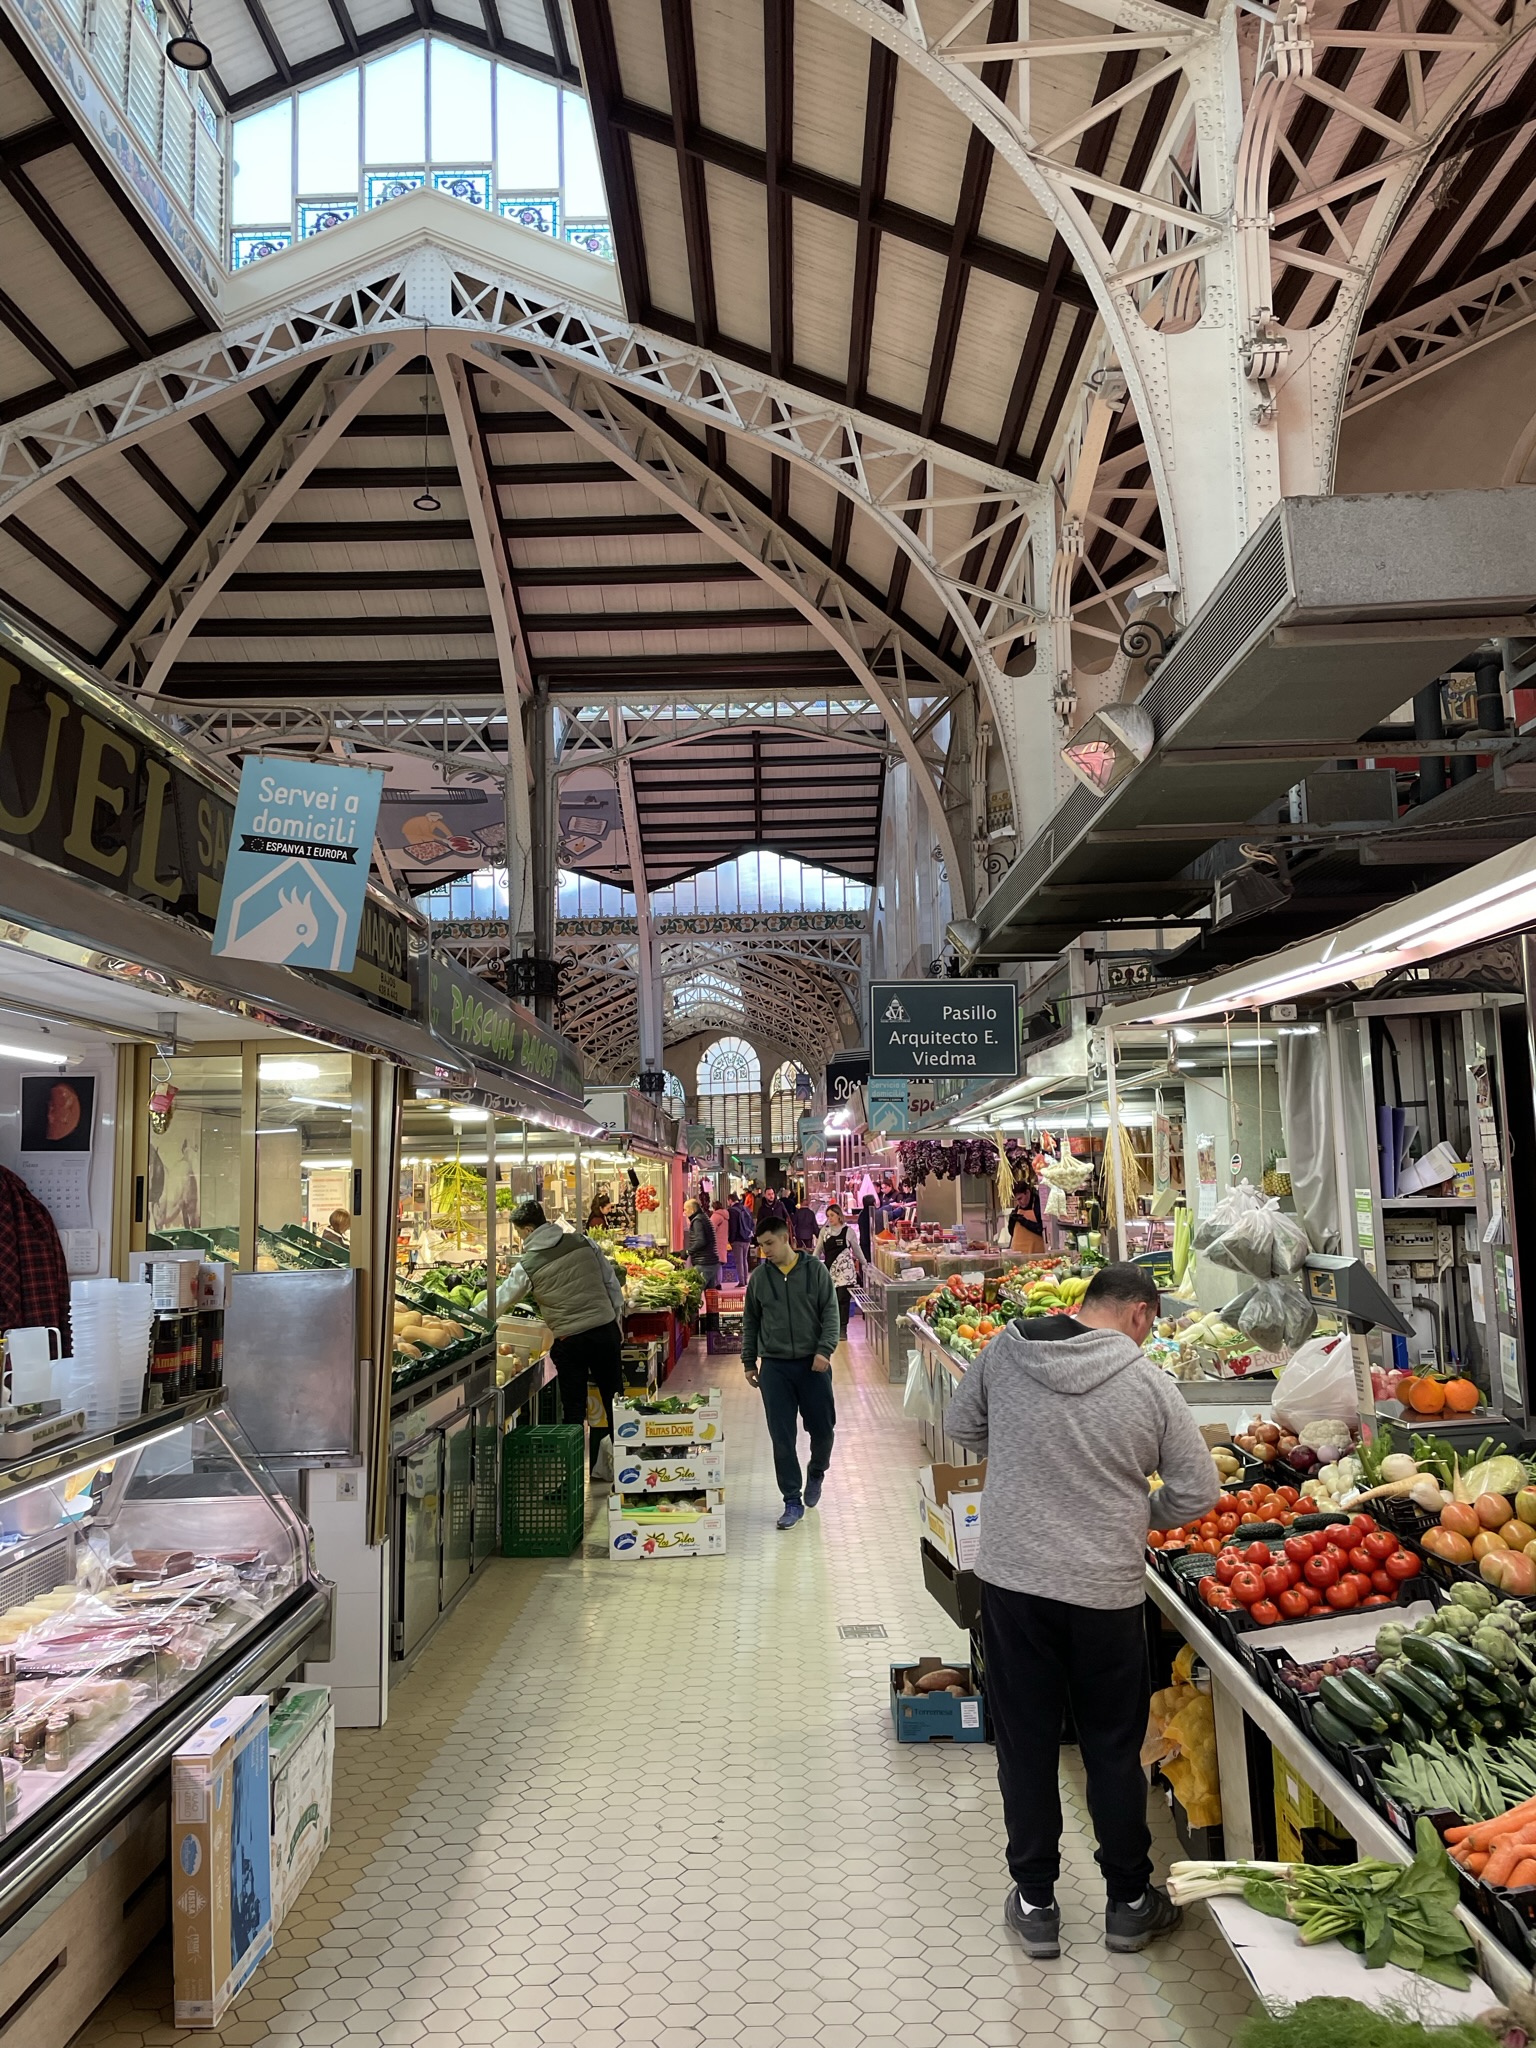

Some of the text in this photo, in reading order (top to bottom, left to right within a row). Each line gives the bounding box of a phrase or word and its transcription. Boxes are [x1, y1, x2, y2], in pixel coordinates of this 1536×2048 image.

[258, 776, 360, 814] Servei a
[252, 808, 357, 845] domicili
[265, 841, 348, 861] ESPANYA I EUROPA
[359, 908, 402, 973] MADOS
[942, 1004, 997, 1021] Pasillo
[451, 984, 516, 1062] PASCUAL
[888, 1030, 999, 1048] Arquitecto E.
[912, 1050, 977, 1066] Viedma
[870, 1080, 899, 1089] Servicio
[871, 1089, 906, 1097] domicilio
[645, 1425, 694, 1436] FRUTAS DONIZ
